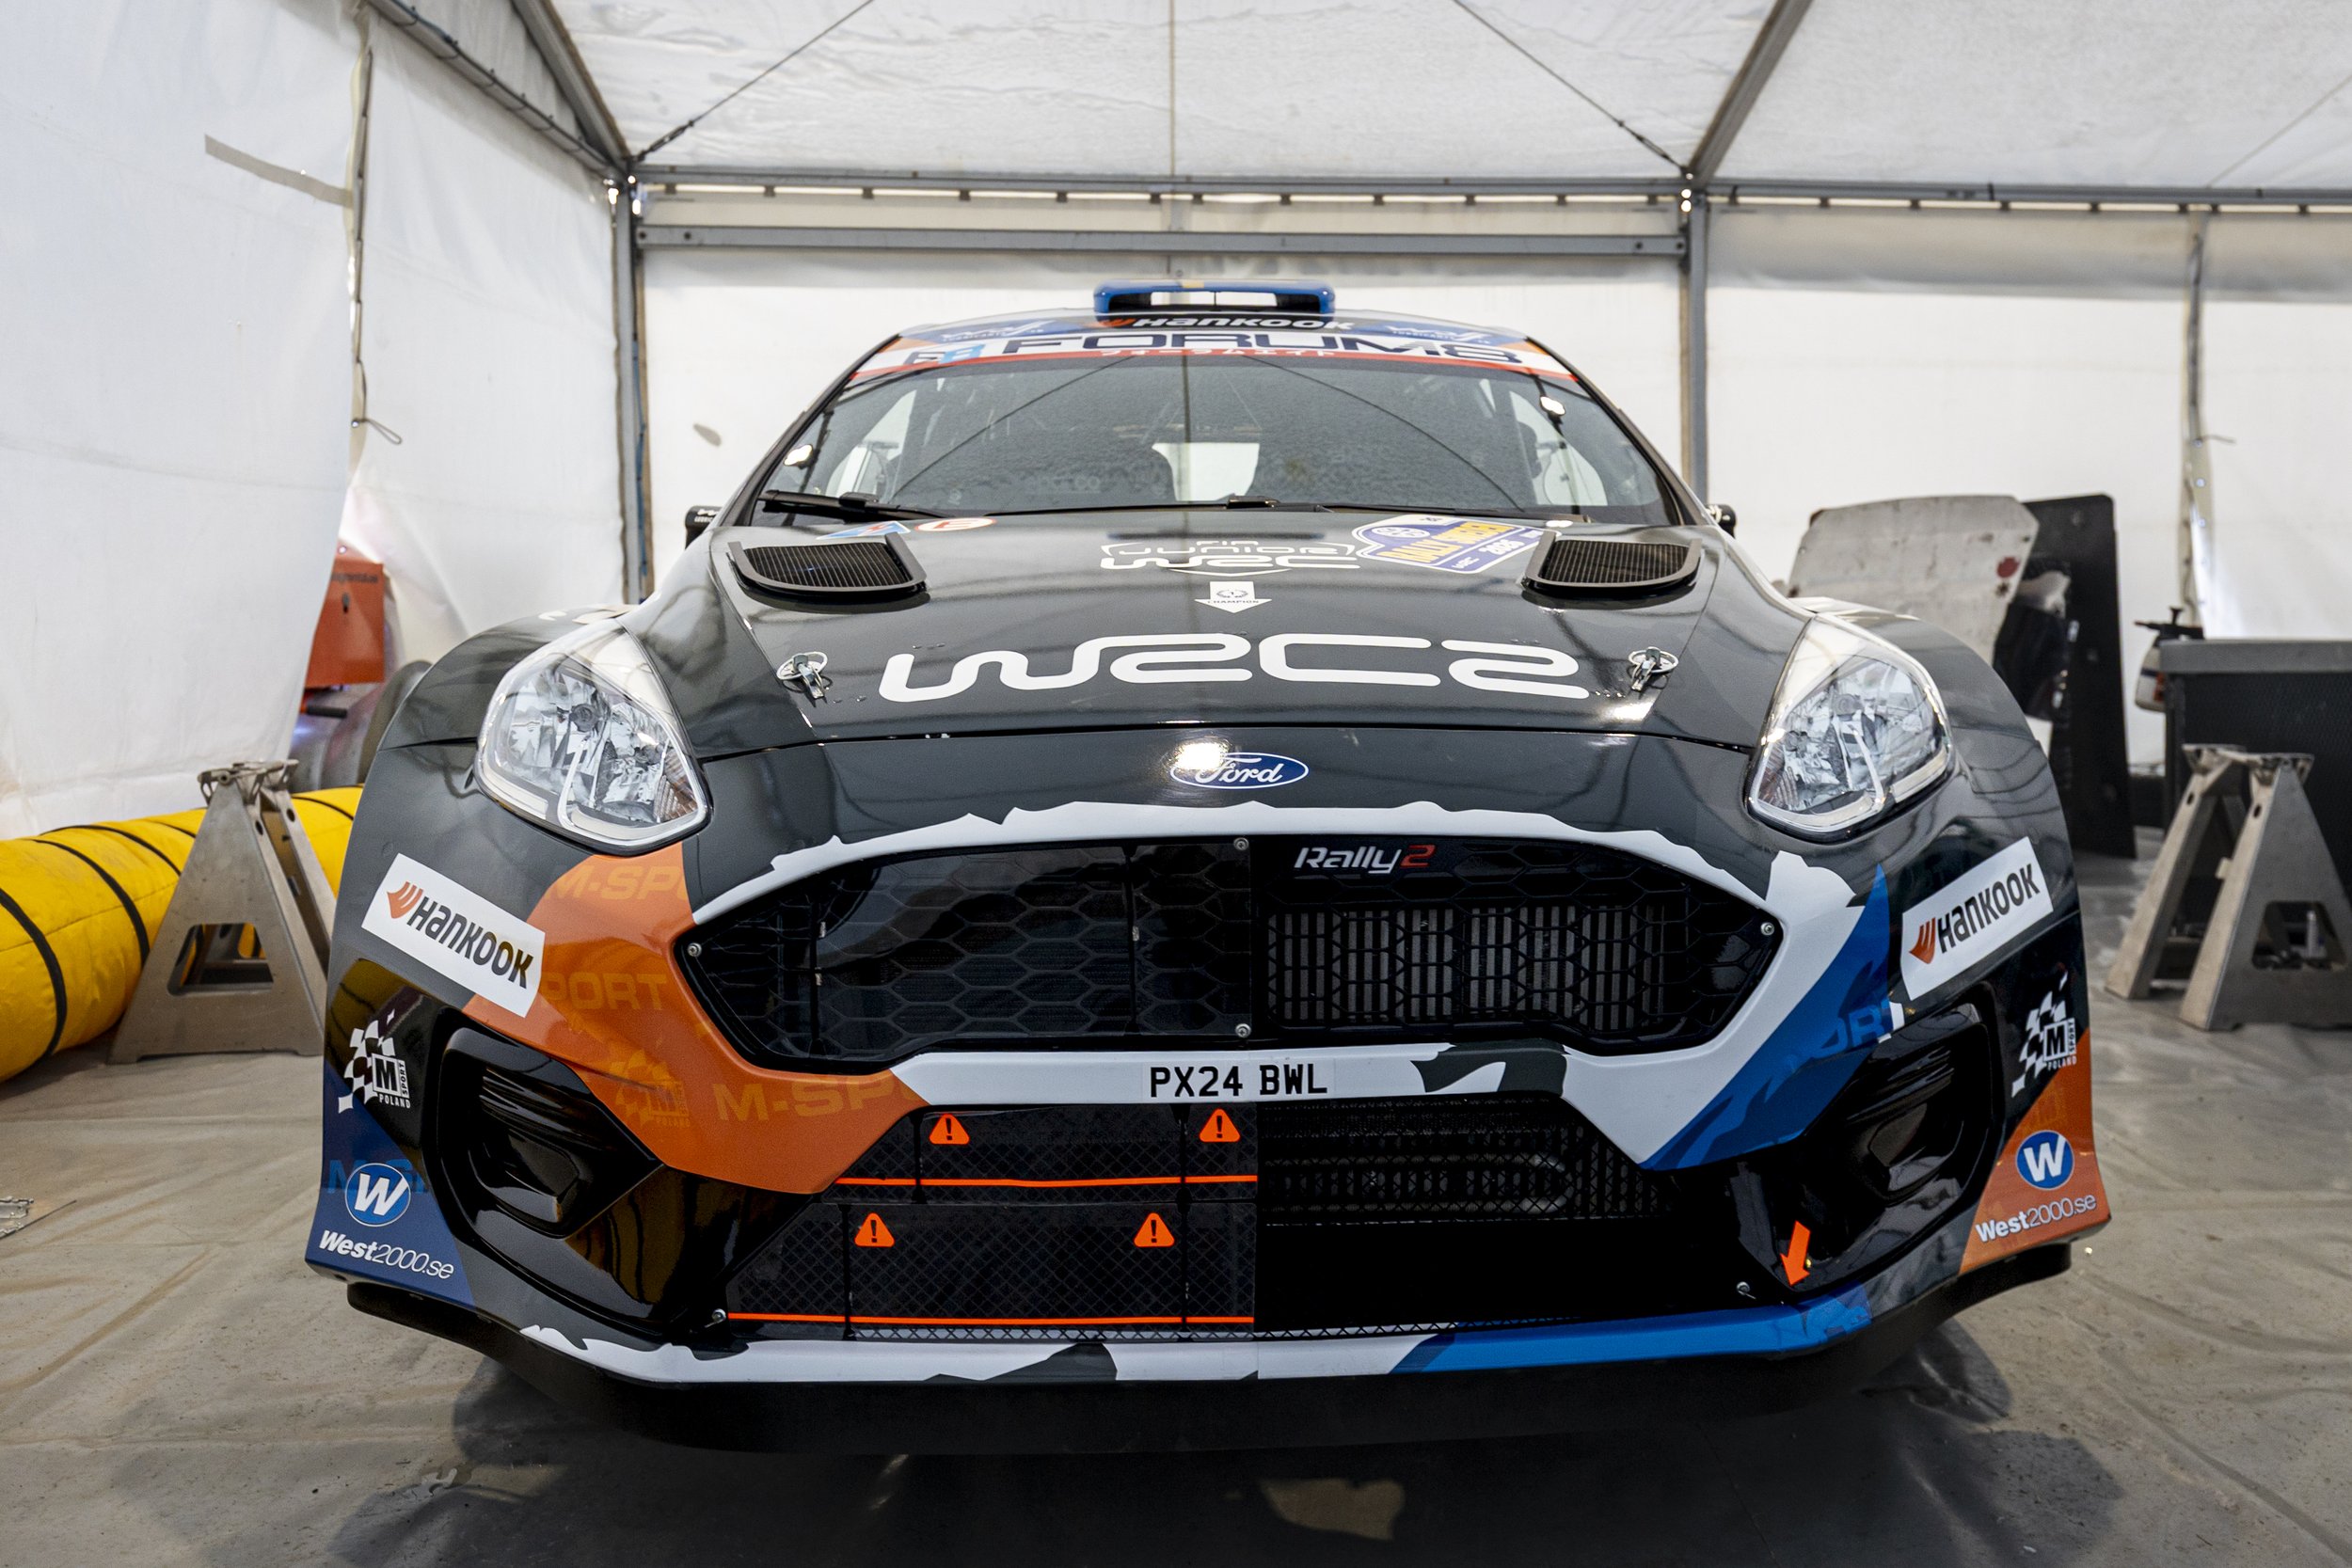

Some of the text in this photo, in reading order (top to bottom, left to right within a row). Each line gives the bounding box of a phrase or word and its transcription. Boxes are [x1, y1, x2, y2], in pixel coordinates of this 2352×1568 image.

[1002, 333, 1522, 364] FORUM8
[1100, 554, 1361, 570] WRC
[1118, 546, 1339, 555] JUNIOR
[878, 633, 1590, 703] WRC2
[1194, 756, 1285, 784] Ford
[2046, 1025, 2065, 1055] M
[375, 1058, 408, 1097] M SPORT
[2048, 1055, 2077, 1070] POLAND
[1150, 1063, 1328, 1098] PX24 BWL
[378, 1093, 411, 1109] POLAND
[2023, 1133, 2067, 1183] W
[354, 1172, 409, 1217] W
[1975, 1195, 2097, 1243] West2000.se
[318, 1228, 454, 1279] West2000.se
